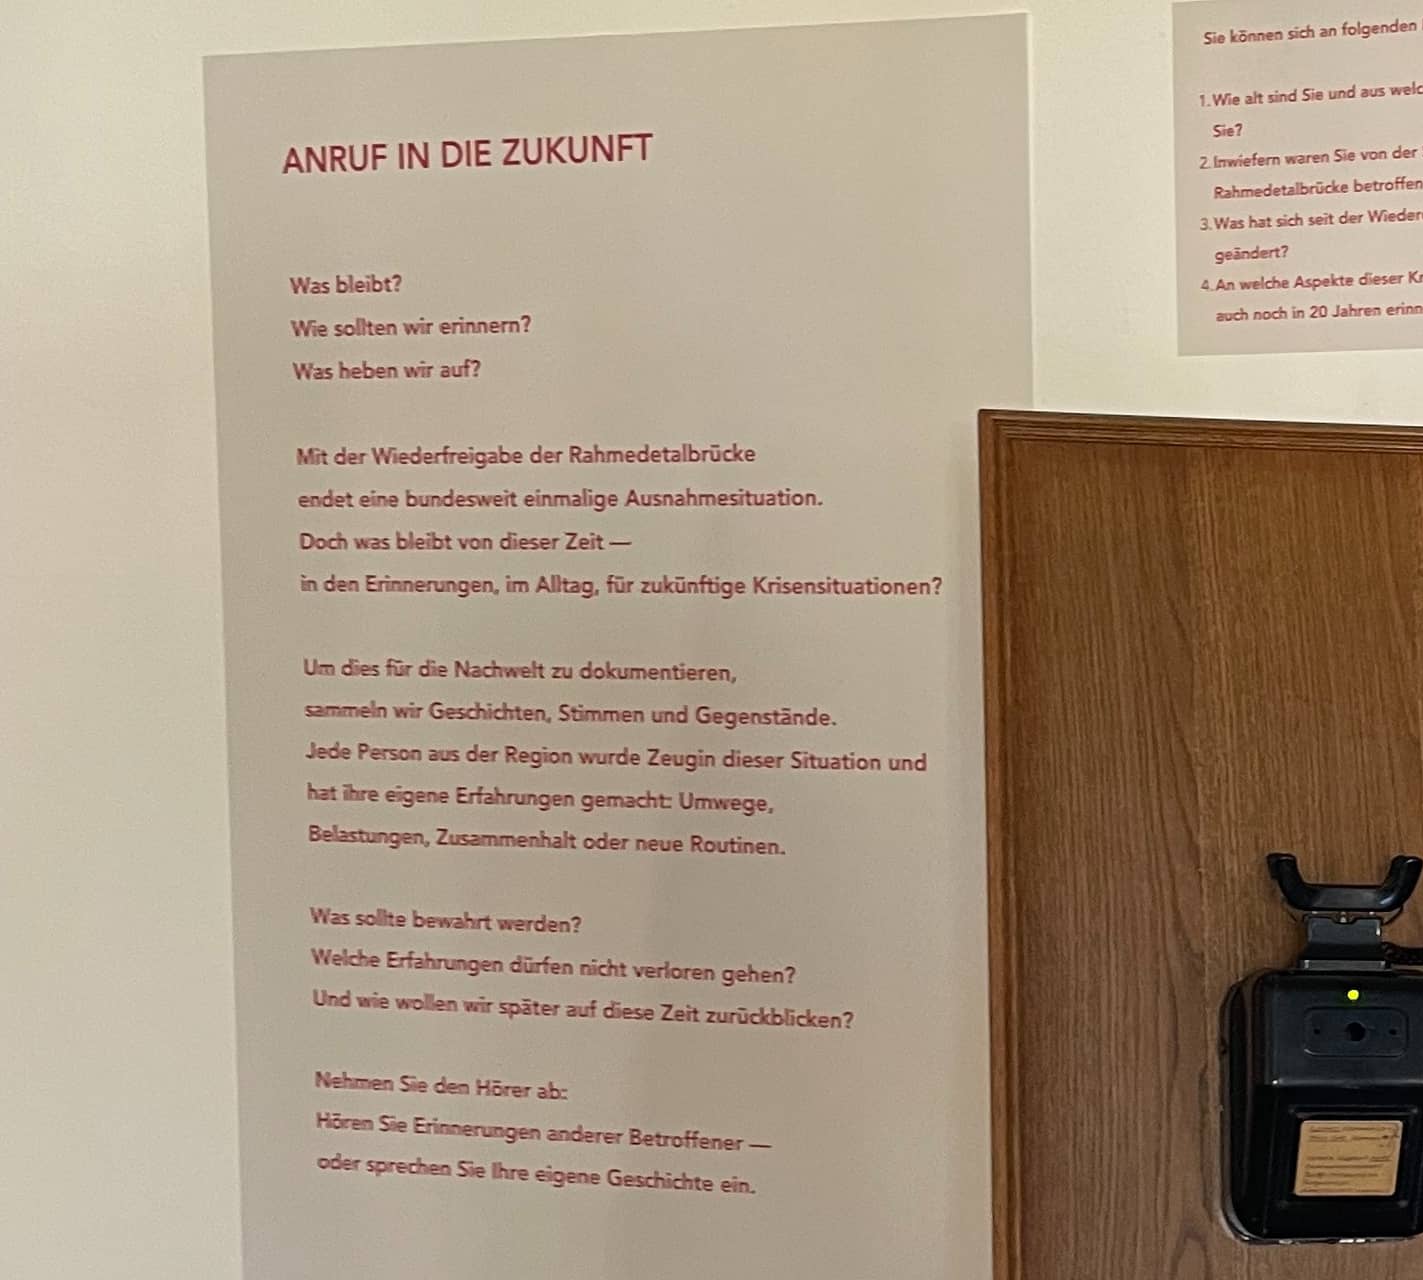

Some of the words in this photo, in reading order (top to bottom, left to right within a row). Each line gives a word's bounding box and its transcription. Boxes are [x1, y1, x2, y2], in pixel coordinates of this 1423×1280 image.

[1204, 32, 1226, 45] Sie
[1230, 30, 1283, 43] können
[1288, 25, 1315, 40] sich
[1319, 28, 1337, 37] an
[1342, 19, 1417, 39] folgenden
[1212, 93, 1241, 107] Wie
[1245, 91, 1264, 104] alt
[1267, 89, 1297, 103] sind
[1302, 88, 1324, 101] Sie
[1328, 84, 1356, 100] und
[1360, 87, 1385, 98] aus
[1213, 123, 1242, 138] Sie?
[283, 144, 387, 174] ANRUF
[399, 142, 429, 169] IN
[442, 140, 492, 168] DIE
[502, 133, 653, 165] ZUKUNFT
[1214, 152, 1280, 168] Inwiefern
[1285, 153, 1329, 164] waren
[1333, 149, 1356, 162] Sie
[1360, 151, 1387, 160] von
[1392, 145, 1418, 159] der
[1214, 180, 1348, 199] Rahmedetalbrücke
[1214, 217, 1245, 230] Was
[1249, 216, 1272, 228] hat
[1276, 213, 1303, 227] sich
[1308, 213, 1334, 226] seit
[1339, 211, 1364, 224] der
[1215, 245, 1288, 264] geändert?
[290, 277, 330, 294] Was
[336, 274, 402, 293] bleibt?
[1239, 276, 1289, 290] welche
[1293, 274, 1354, 291] Aspekte
[1359, 272, 1404, 285] dieser
[1216, 308, 1248, 322] auch
[1253, 306, 1287, 320] noch
[1292, 307, 1304, 319] in
[1310, 305, 1328, 318] 20
[1332, 304, 1381, 317] Jahren
[291, 320, 328, 337] Wie
[334, 318, 397, 337] sollten
[403, 317, 433, 335] wir
[439, 315, 531, 335] erinnern?
[293, 362, 333, 380] Was
[339, 361, 398, 379] heben
[404, 361, 434, 378] wir
[440, 359, 481, 378] auf?
[297, 448, 328, 465] Mit
[334, 447, 367, 465] der
[371, 446, 523, 469] Wiederfreigabe
[530, 445, 563, 463] der
[569, 443, 756, 463] Rahmedetalbrücke
[298, 489, 354, 508] endet
[359, 490, 399, 507] eine
[406, 489, 518, 507] bundesweit
[524, 488, 618, 512] einmalige
[624, 488, 823, 507] Ausnahmesituation.
[300, 532, 348, 550] Doch
[354, 538, 390, 550] was
[396, 532, 452, 550] bleibt
[457, 538, 493, 550] von
[500, 532, 560, 550] dieser
[565, 532, 605, 550] Zeit
[301, 575, 318, 591] in
[323, 574, 359, 592] den
[366, 575, 499, 598] Erinnerungen,
[506, 575, 529, 592] im
[535, 575, 599, 599] Alltag,
[606, 575, 634, 593] für
[640, 575, 746, 599] zukünftige
[753, 576, 942, 595] Krisensituationen?
[304, 659, 335, 676] Um
[385, 658, 413, 676] für
[455, 660, 545, 679] Nachwelt
[552, 667, 573, 679] zu
[579, 661, 736, 684] dokumentieren,
[428, 702, 551, 723] Geschichten,
[558, 704, 644, 723] Stimmen
[651, 705, 688, 723] und
[695, 706, 836, 730] Gegenstände.
[306, 742, 352, 760] Jede
[358, 743, 421, 761] Person
[429, 749, 460, 762] aus
[466, 744, 499, 762] der
[504, 746, 572, 768] Region
[578, 747, 640, 765] wurde
[647, 748, 716, 772] Zeugin
[722, 749, 784, 768] dieser
[791, 751, 881, 770] Situation
[888, 753, 927, 771] und
[385, 786, 449, 808] eigene
[456, 786, 575, 811] Erfahrungen
[581, 790, 672, 812] gemacht:
[679, 792, 773, 816] Umwege,
[309, 825, 430, 849] Belastungen,
[436, 828, 576, 849] Zusammenhalt
[583, 832, 630, 850] oder
[635, 839, 683, 852] neue
[690, 835, 785, 855] Routinen.
[310, 907, 350, 925] Was
[356, 909, 406, 927] sollte
[412, 910, 492, 930] bewahrt
[496, 915, 582, 933] werden?
[311, 949, 380, 967] Welche
[387, 951, 503, 976] Erfahrungen
[510, 955, 573, 974] dürfen
[580, 959, 627, 977] nicht
[632, 961, 715, 981] verloren
[722, 964, 796, 987] gehen?
[313, 990, 351, 1007] Und
[499, 999, 560, 1019] später
[566, 1000, 597, 1018] auf
[603, 1001, 655, 1021] diese
[660, 1004, 700, 1022] Zeit
[706, 1007, 854, 1029] zurückblicken?
[315, 1071, 393, 1091] Nehmen
[400, 1075, 428, 1093] Sie
[434, 1076, 469, 1094] den
[476, 1079, 532, 1098] Hörer
[537, 1081, 568, 1100] ab:
[317, 1112, 373, 1130] Hören
[379, 1115, 407, 1132] Sie
[414, 1117, 541, 1144] Erinnerungen
[547, 1125, 624, 1144] anderer
[629, 1128, 744, 1151] Betroffener
[317, 1153, 361, 1170] oder
[367, 1158, 451, 1176] sprechen
[456, 1160, 486, 1178] Sie
[535, 1165, 600, 1188] eigene
[607, 1169, 714, 1192] Geschichte
[720, 1176, 756, 1194] ein.
